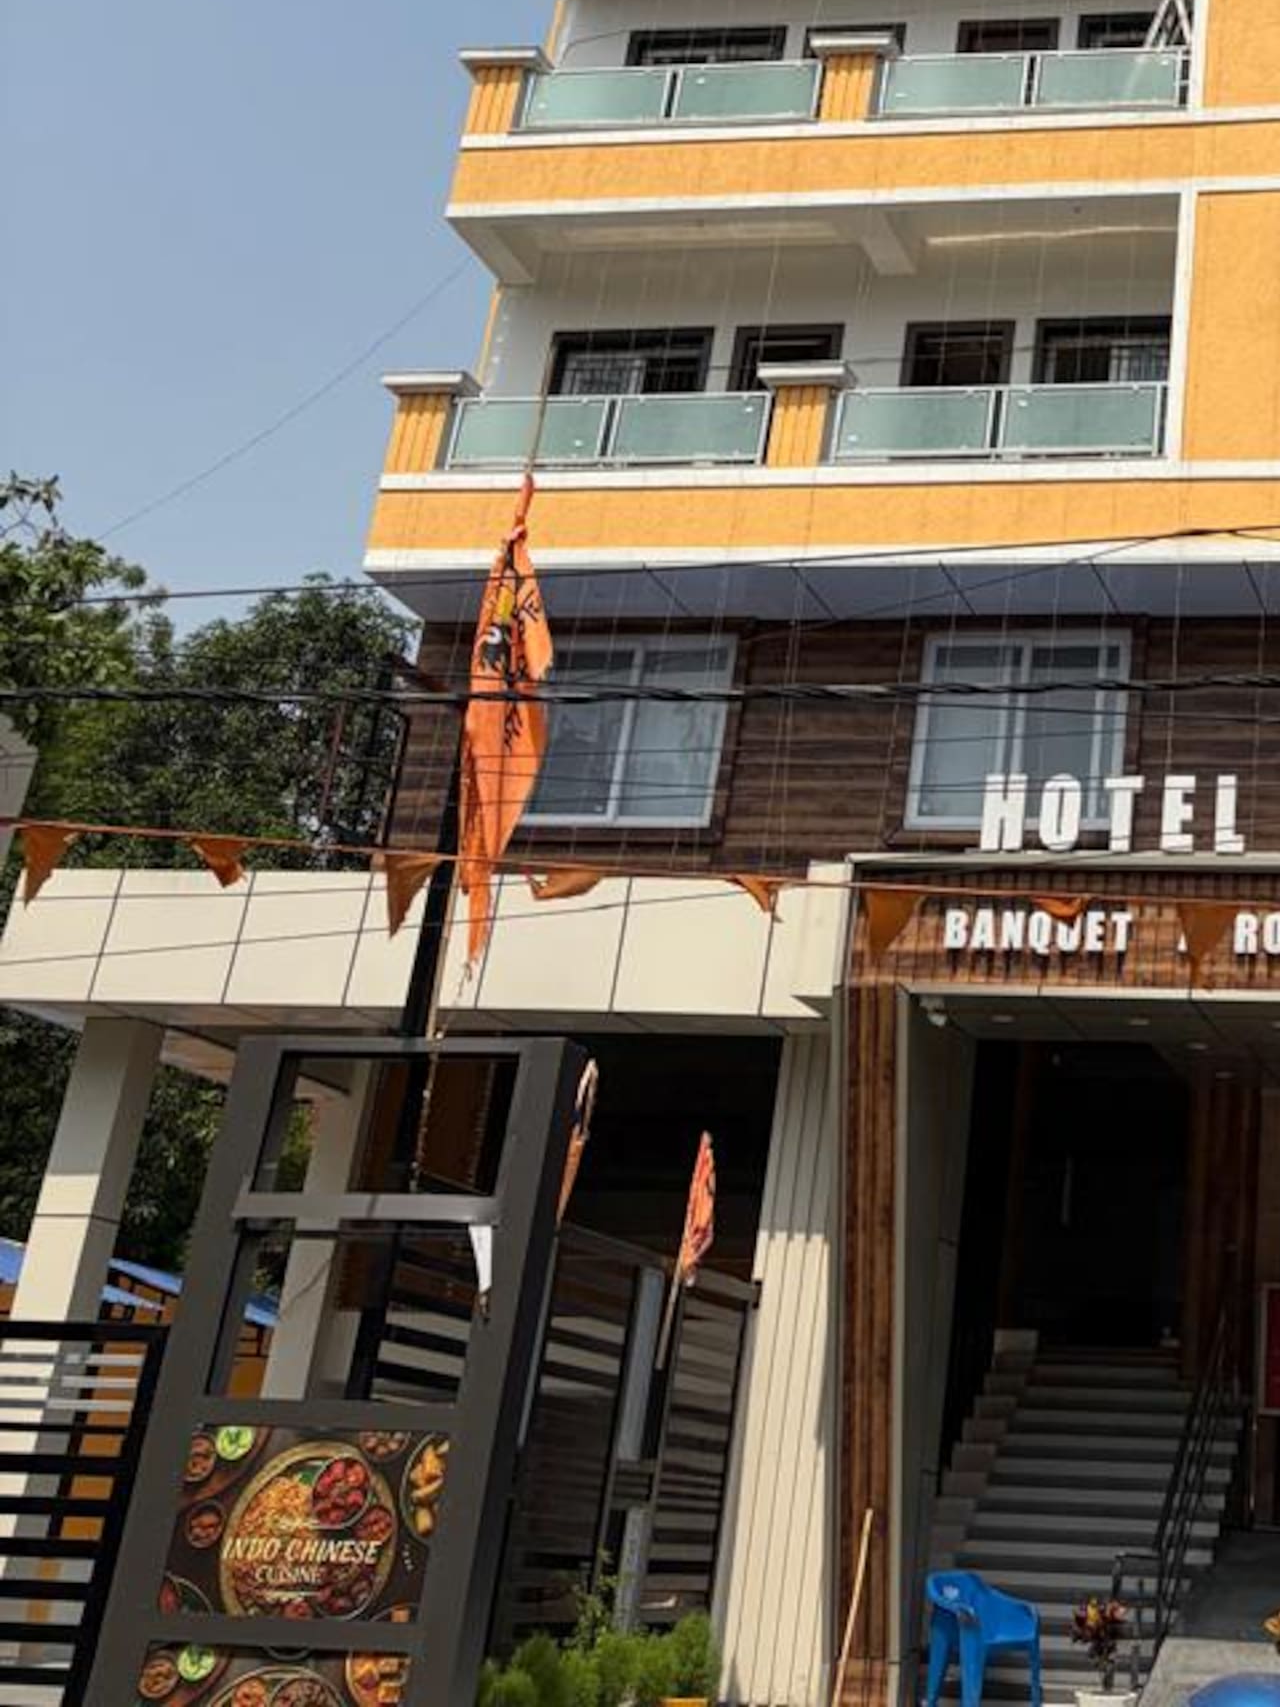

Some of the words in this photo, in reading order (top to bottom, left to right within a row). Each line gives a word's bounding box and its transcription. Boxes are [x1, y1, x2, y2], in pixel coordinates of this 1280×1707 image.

[980, 773, 1246, 853] HOTEL
[944, 908, 1133, 955] BANQUET
[222, 1537, 281, 1561] INDO
[284, 1539, 383, 1565] CHINESE
